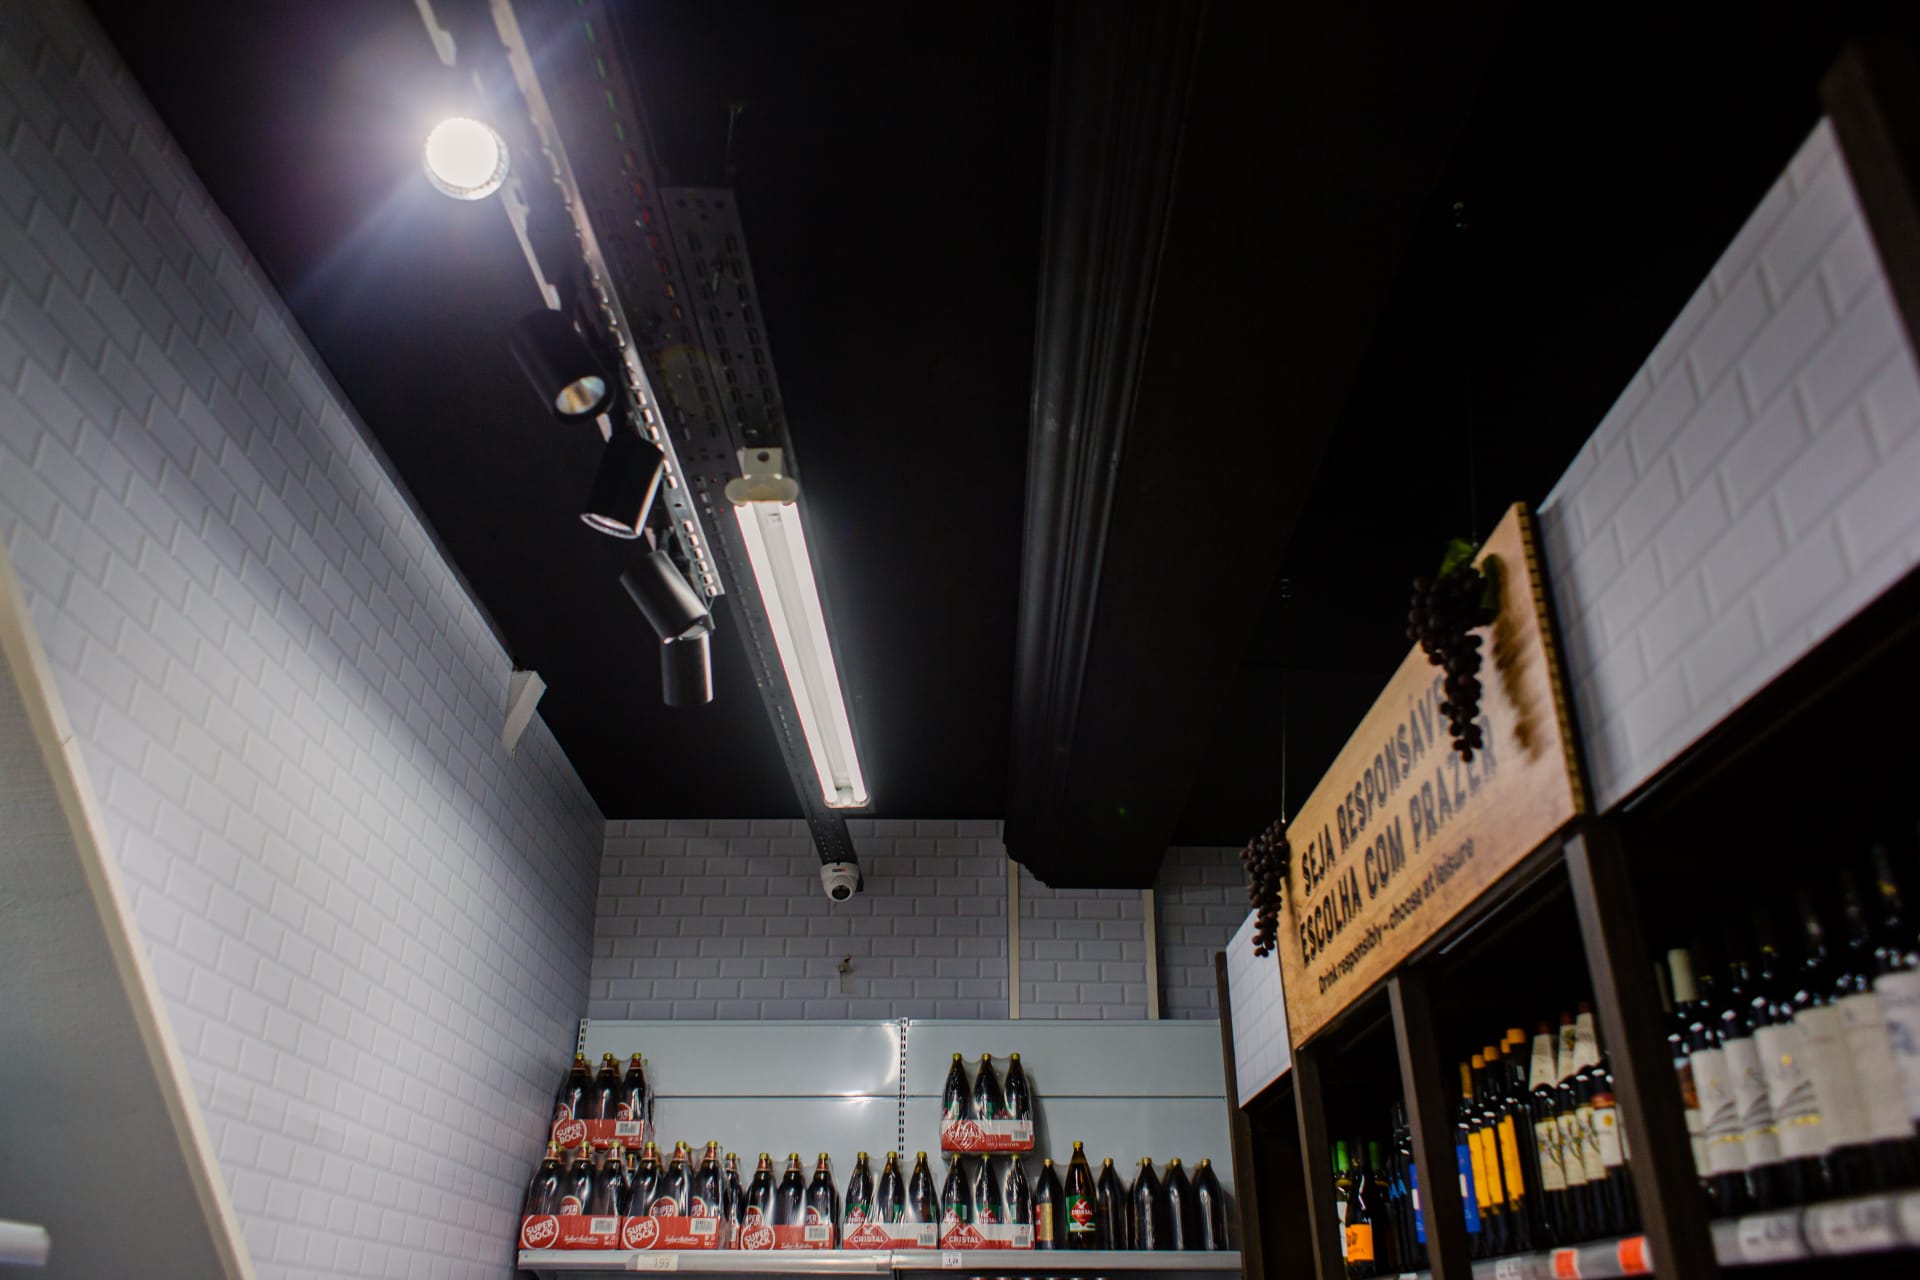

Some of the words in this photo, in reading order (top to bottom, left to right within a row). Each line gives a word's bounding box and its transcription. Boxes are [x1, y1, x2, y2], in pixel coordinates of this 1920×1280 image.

[1302, 823, 1336, 897] SEJA
[1336, 673, 1448, 855] RESPONSÁVE
[1300, 865, 1363, 969] ESCOLHA
[1365, 815, 1406, 900] COM
[1409, 714, 1498, 854] PRAZER
[1318, 963, 1339, 995] Drink
[1337, 923, 1383, 978] responsibly
[1389, 887, 1423, 930] choose
[1422, 871, 1436, 899] at
[1433, 837, 1475, 886] leisure
[556, 1122, 583, 1137] SUPER
[559, 1130, 583, 1145] BOCK
[526, 1219, 554, 1235] SUPER
[528, 1227, 555, 1243] BOCK
[626, 1219, 654, 1236] SUPER
[629, 1228, 655, 1244] BOCK
[744, 1228, 771, 1243] SUPER
[853, 1235, 884, 1243] CRISTAL
[948, 1235, 979, 1243] CRISTAL
